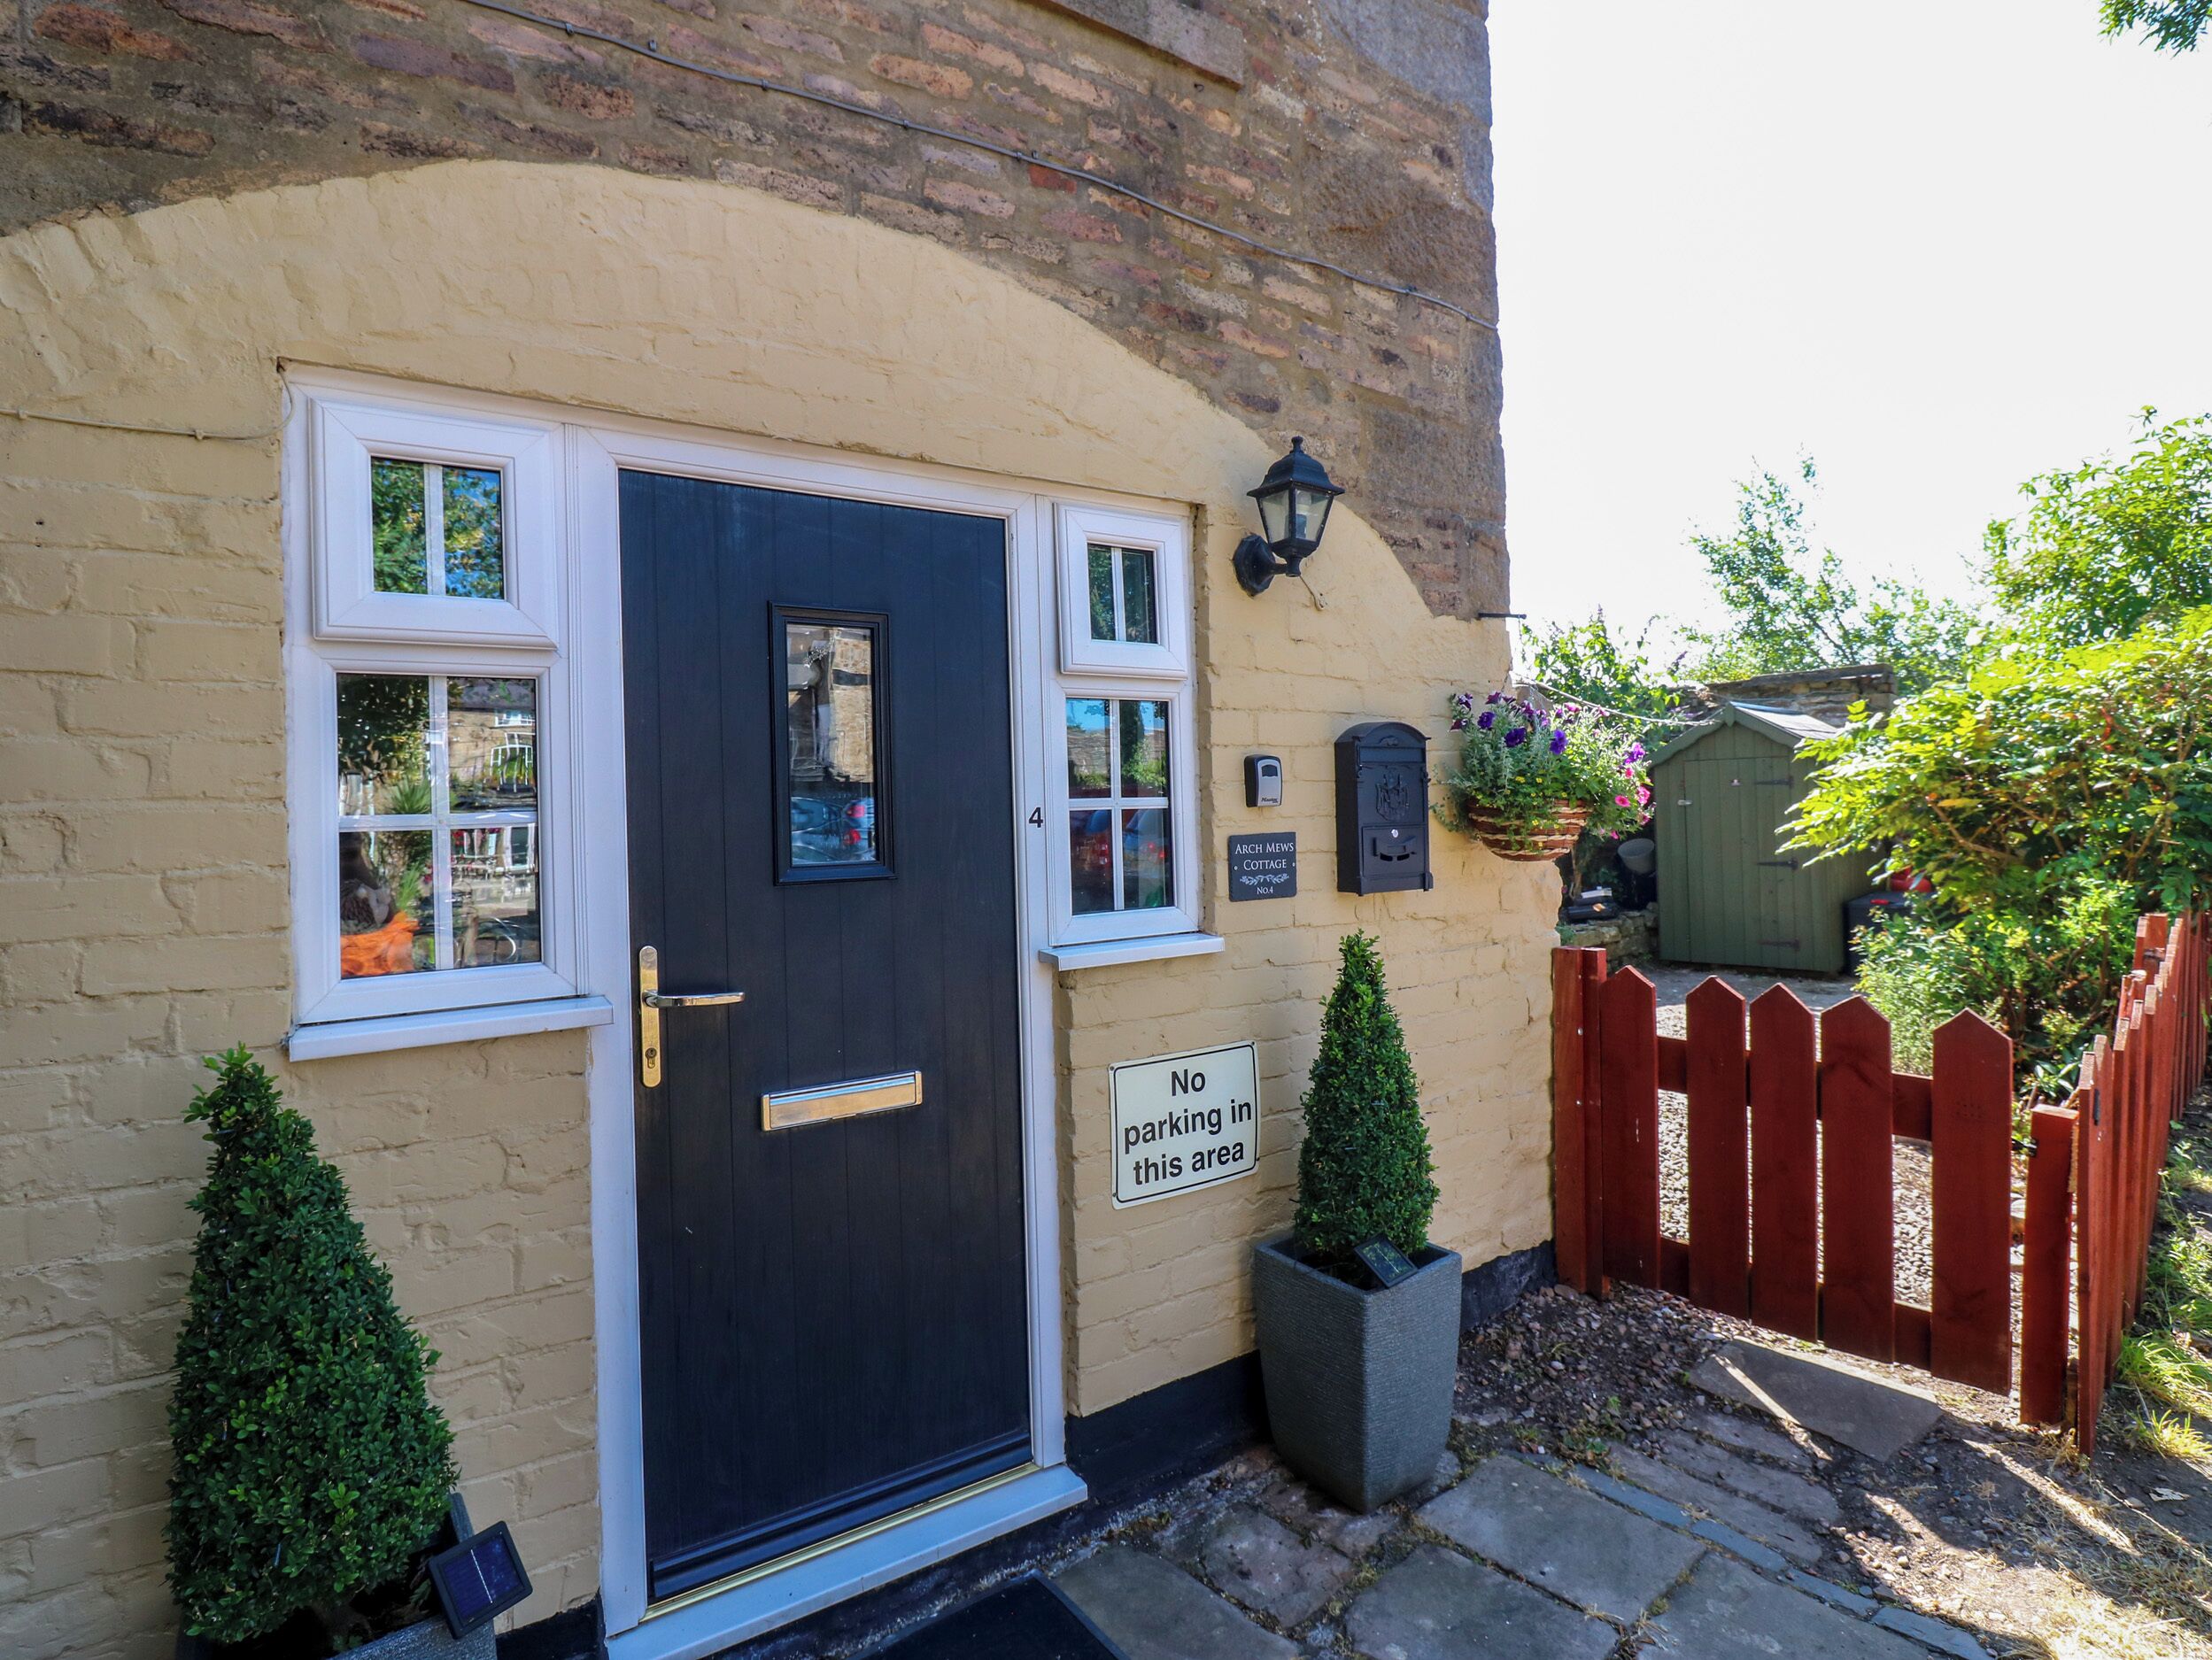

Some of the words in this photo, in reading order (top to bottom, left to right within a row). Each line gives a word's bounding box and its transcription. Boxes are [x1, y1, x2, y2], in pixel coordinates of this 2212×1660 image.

[1028, 807, 1044, 829] 4
[1234, 844, 1263, 854] ARCH
[1265, 842, 1295, 853] MEWS
[1243, 859, 1288, 871] COTTAGE
[1171, 1069, 1206, 1097] No
[1124, 1108, 1222, 1155] parking
[1230, 1099, 1252, 1124] in
[1133, 1154, 1183, 1185] this
[1191, 1141, 1244, 1172] area
